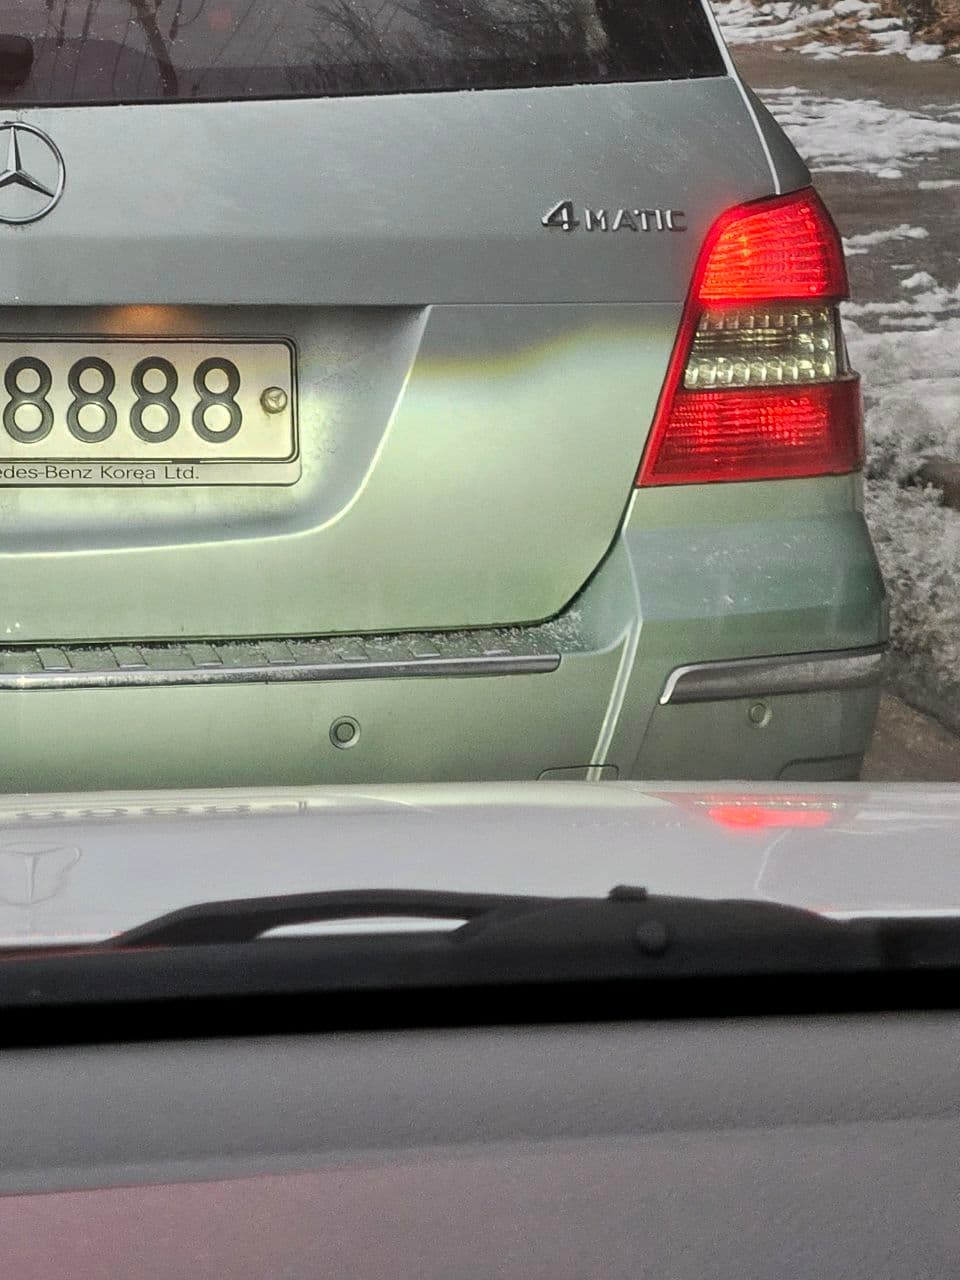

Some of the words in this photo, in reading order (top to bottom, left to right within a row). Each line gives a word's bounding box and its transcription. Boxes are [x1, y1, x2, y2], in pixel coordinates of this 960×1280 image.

[2, 355, 243, 444] 8888
[100, 465, 156, 480] Korea
[164, 465, 200, 480] Ltd.
